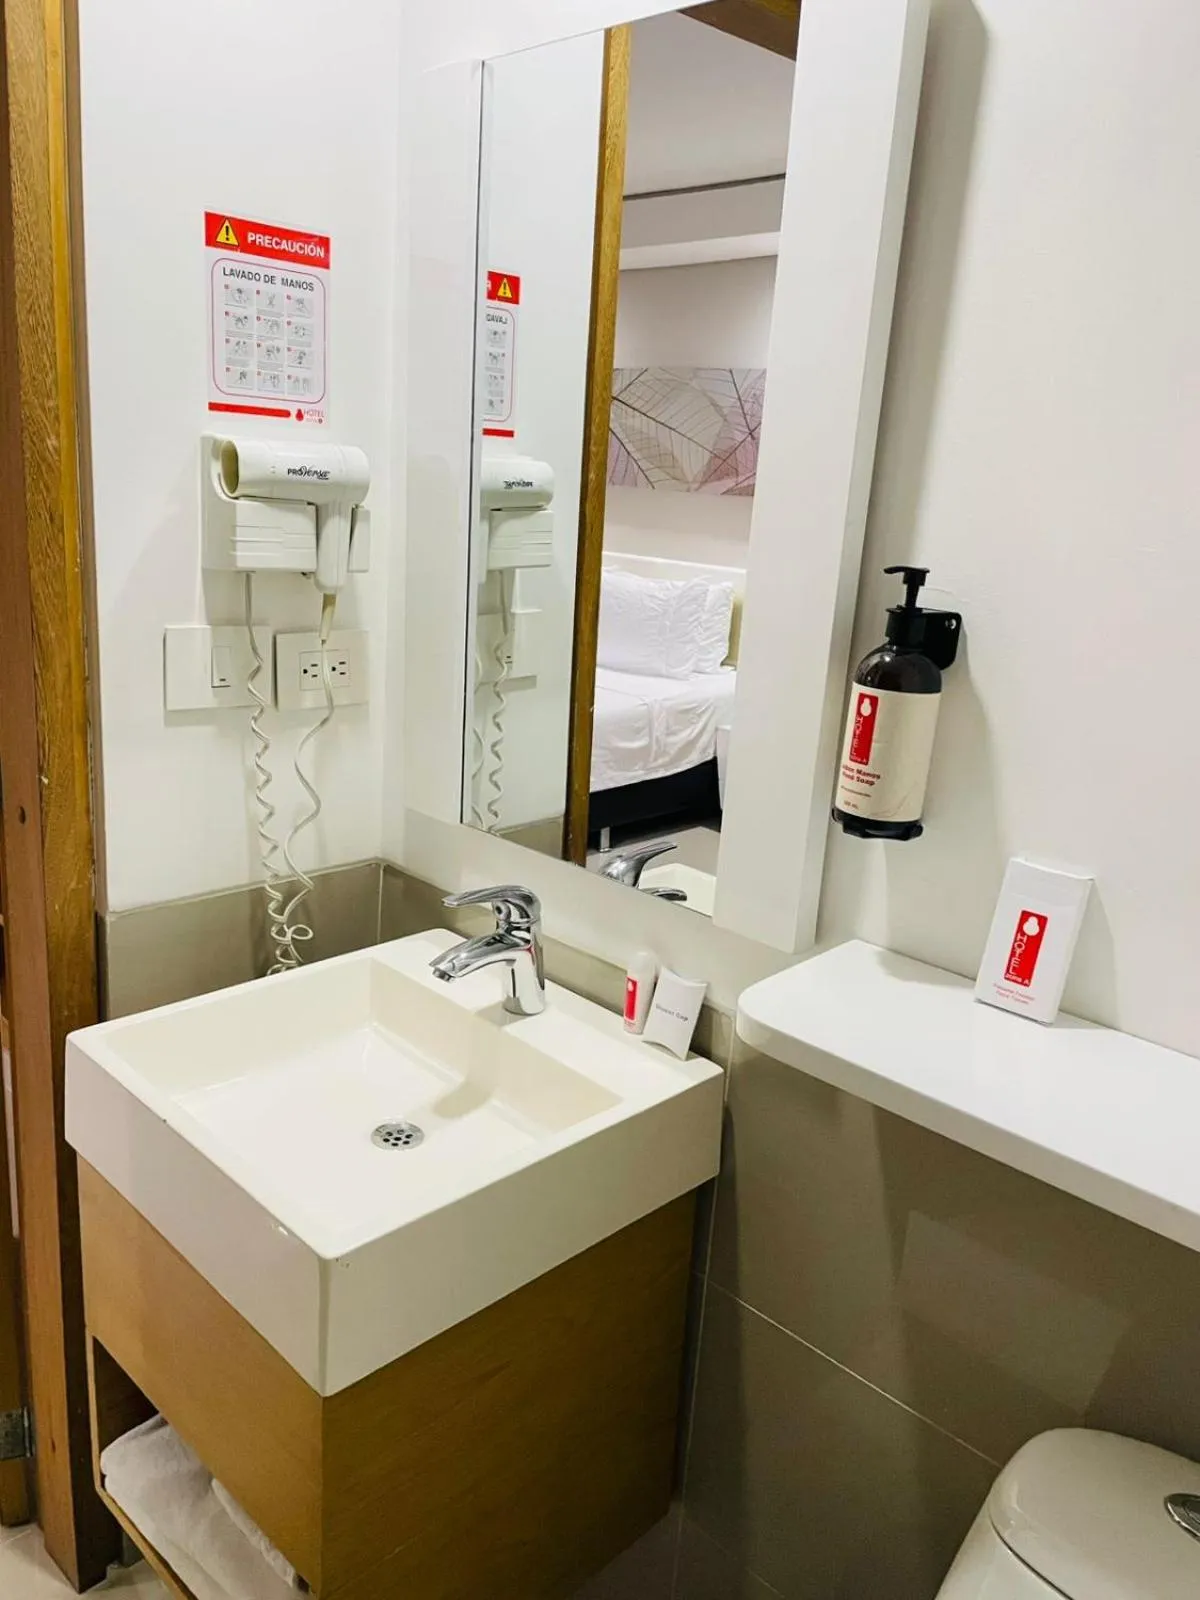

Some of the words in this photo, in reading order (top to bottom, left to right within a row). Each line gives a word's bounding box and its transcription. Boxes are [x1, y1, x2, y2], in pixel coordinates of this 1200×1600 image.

[247, 231, 325, 259] PRECAUCIÓN
[222, 266, 261, 282] LAVADO
[263, 274, 277, 285] DE
[281, 277, 315, 292] MANOS
[1008, 933, 1027, 975] HOTEL
